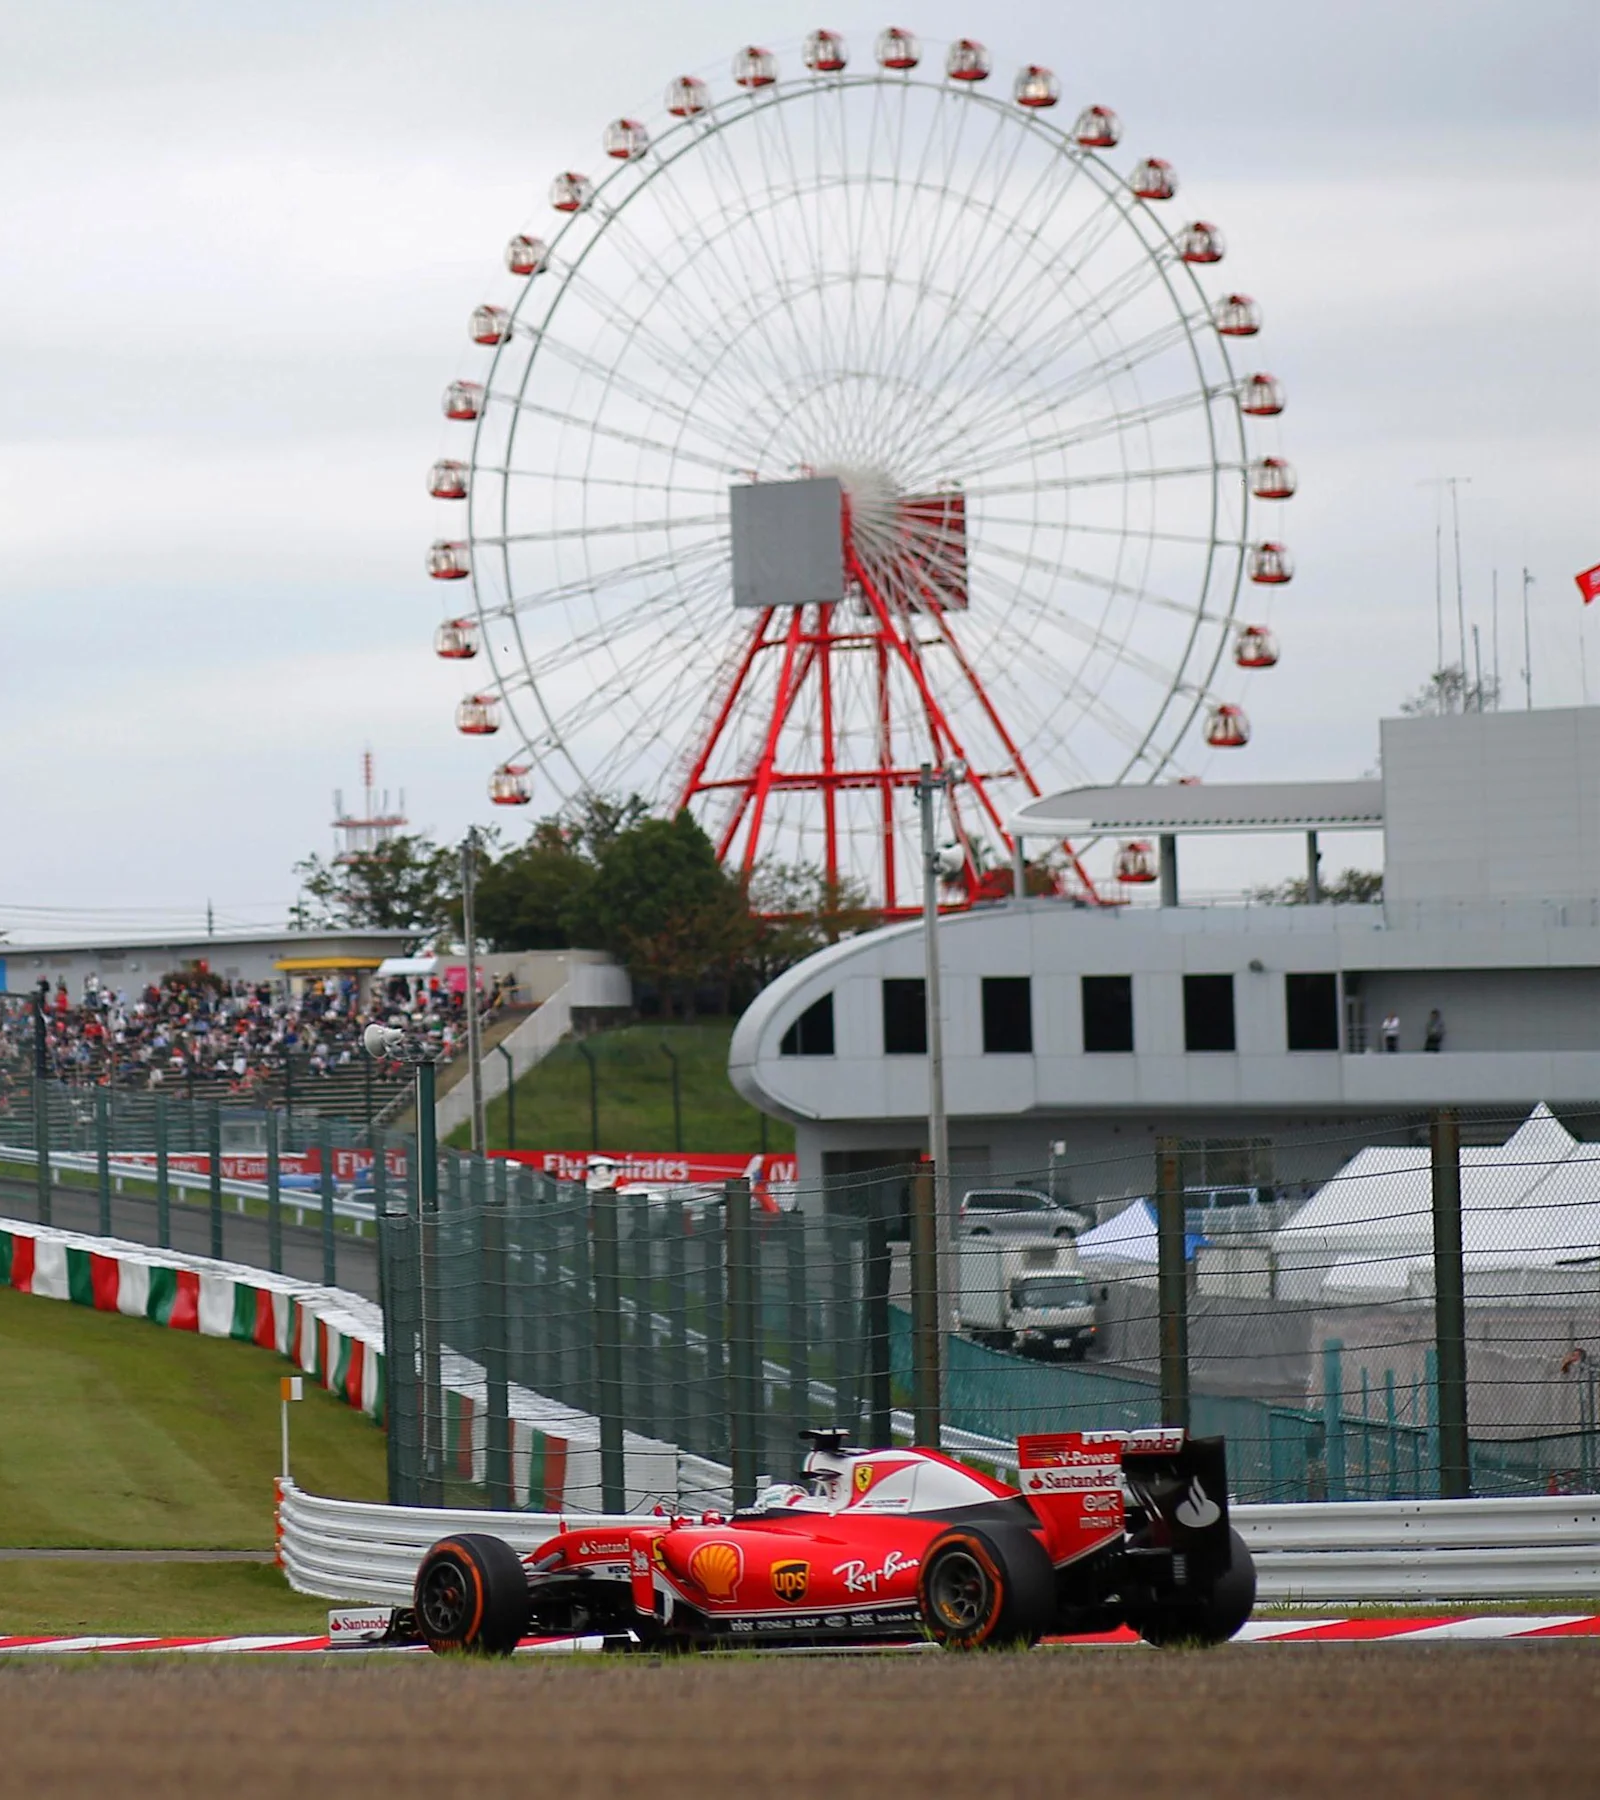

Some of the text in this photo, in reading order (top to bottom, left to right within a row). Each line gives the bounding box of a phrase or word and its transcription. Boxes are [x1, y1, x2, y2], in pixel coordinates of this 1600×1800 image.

[1045, 1469, 1117, 1489] Santander
[590, 1538, 630, 1555] Santand
[773, 1571, 805, 1598] ups
[342, 1615, 389, 1631] Santande
